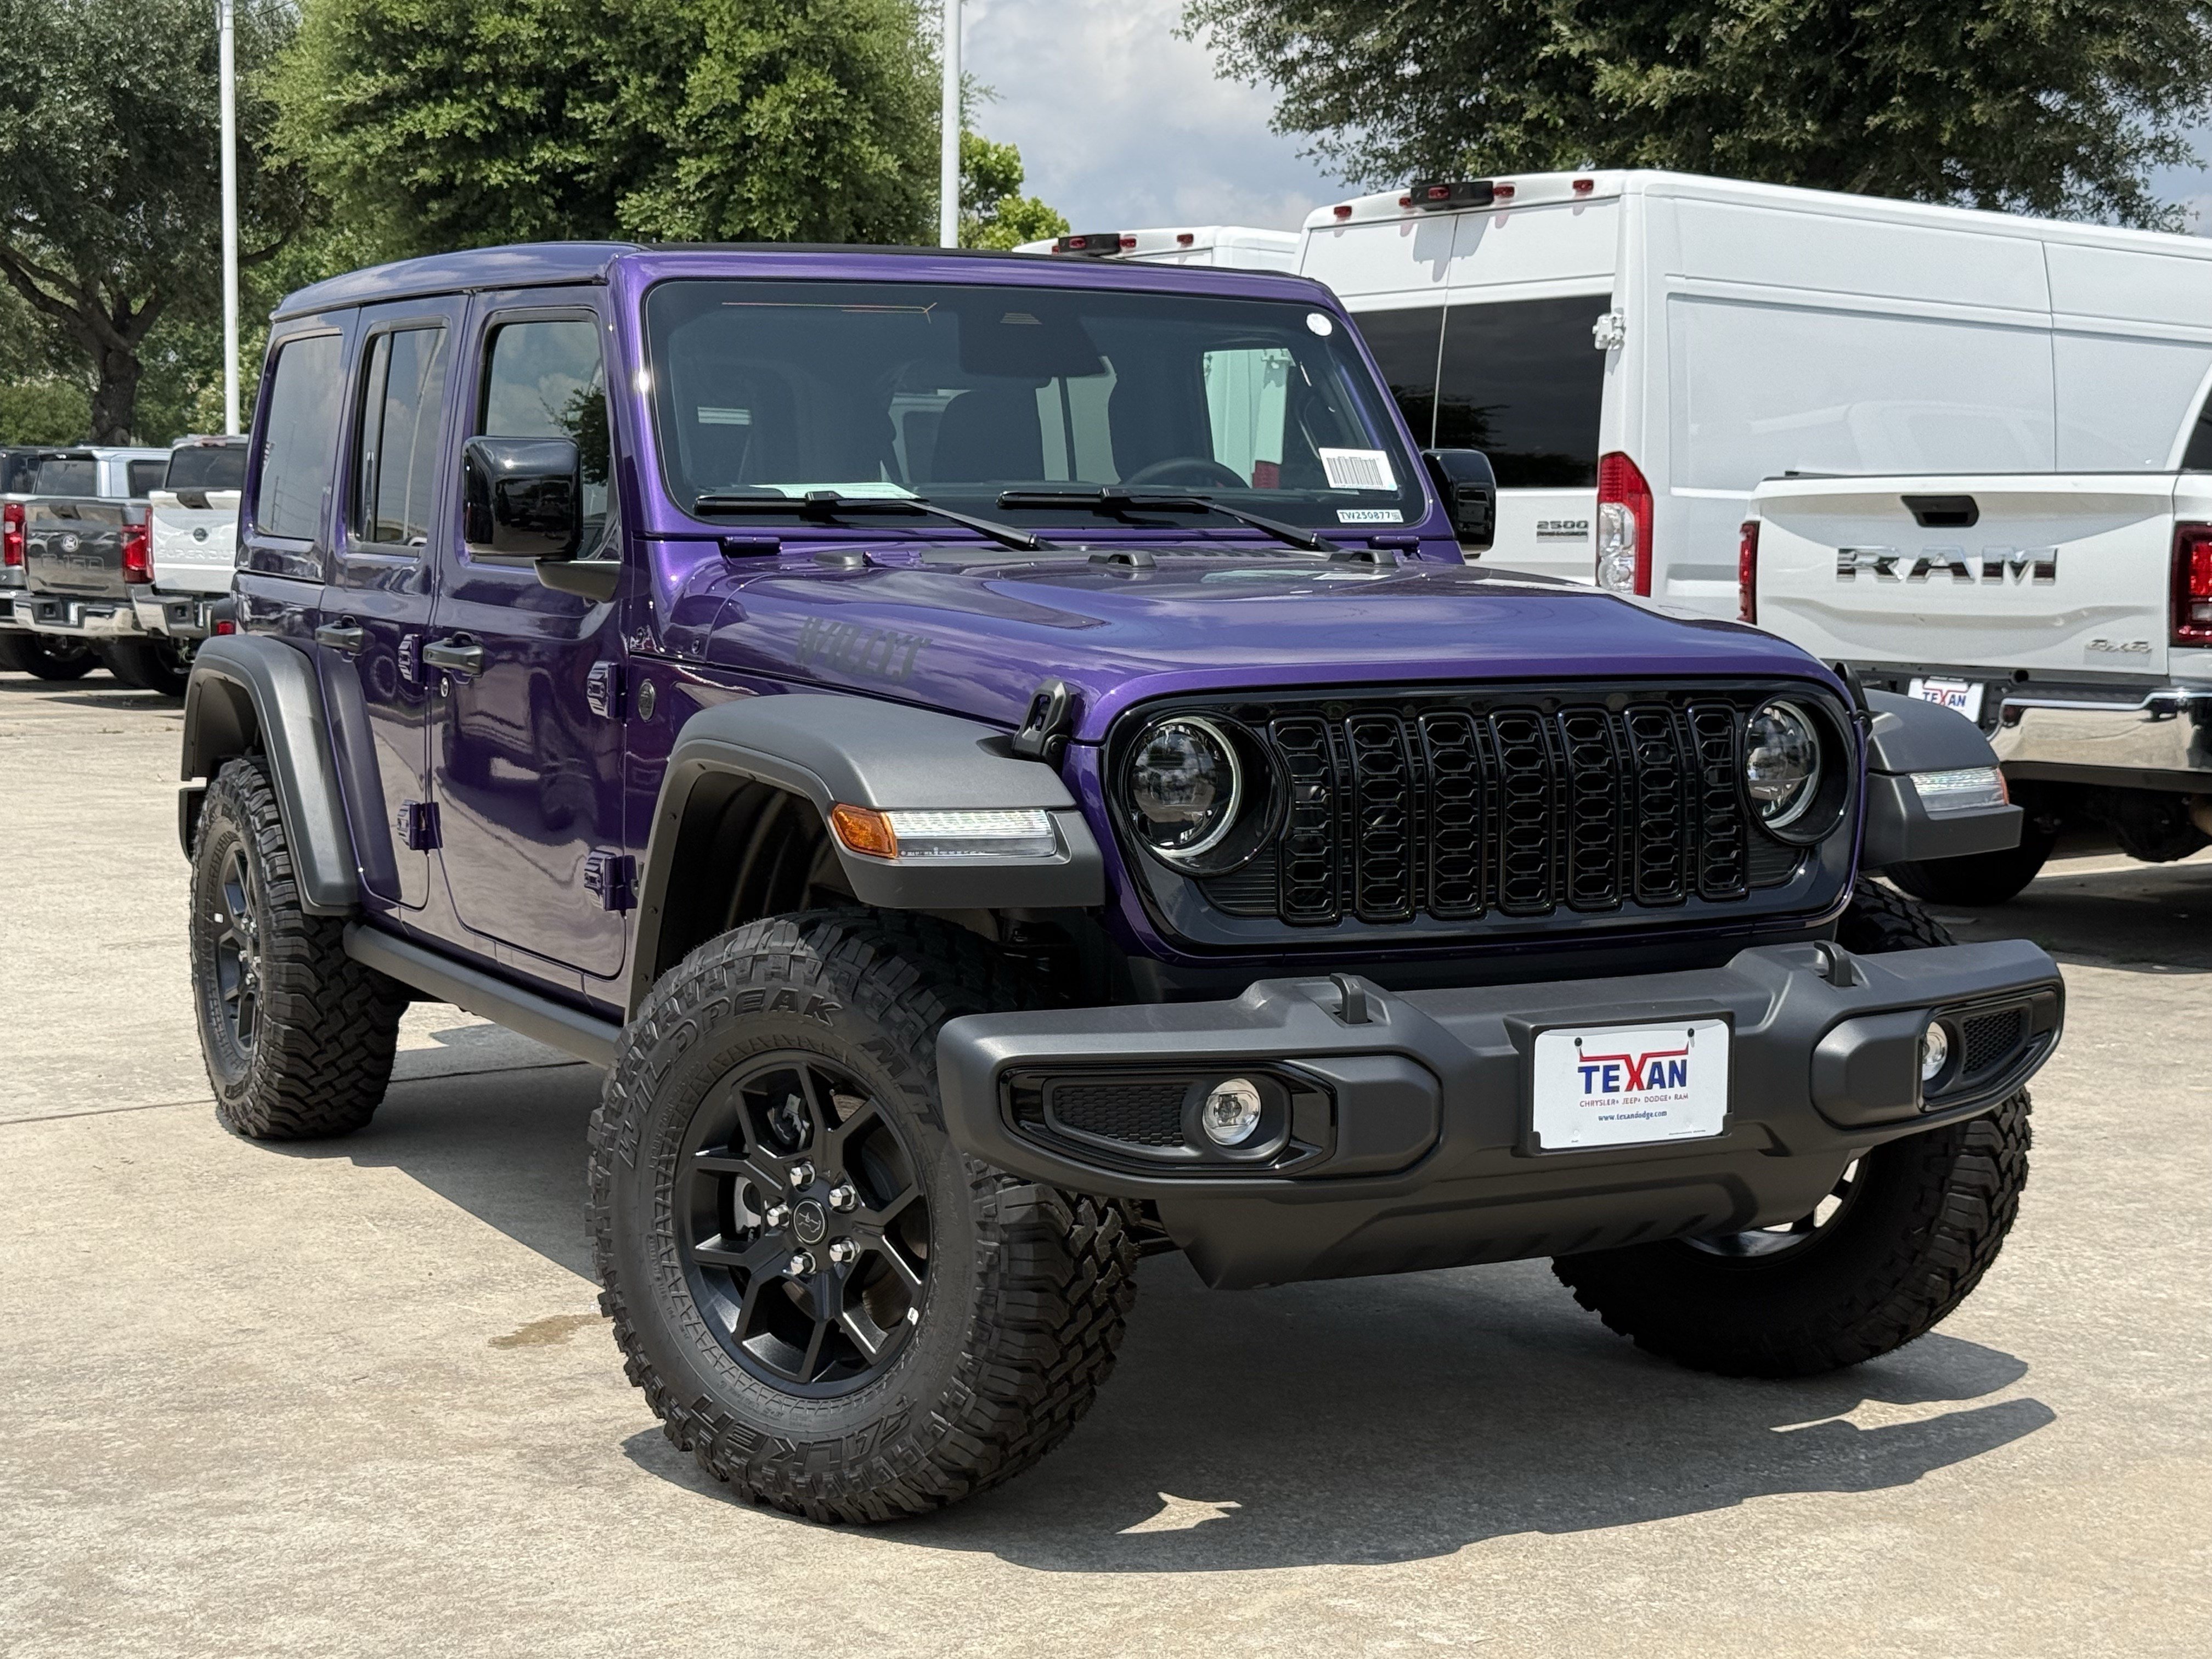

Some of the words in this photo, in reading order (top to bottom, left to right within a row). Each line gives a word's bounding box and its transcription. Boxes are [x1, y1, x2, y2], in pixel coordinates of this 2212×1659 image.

[1537, 521, 1589, 529] 2500
[157, 549, 206, 560] SUPER
[1836, 546, 2062, 585] RAM
[796, 616, 934, 684] WILLYS
[1922, 689, 1967, 707] TEXAN
[618, 986, 844, 1169] WILDPEAK
[1577, 1049, 1689, 1095] TEXAN
[1579, 1098, 1616, 1108] CHRYSLER
[1644, 1094, 1668, 1103] DODGE
[1598, 1110, 1668, 1121] www.texandodge.com
[690, 1392, 917, 1466] FALKEN
